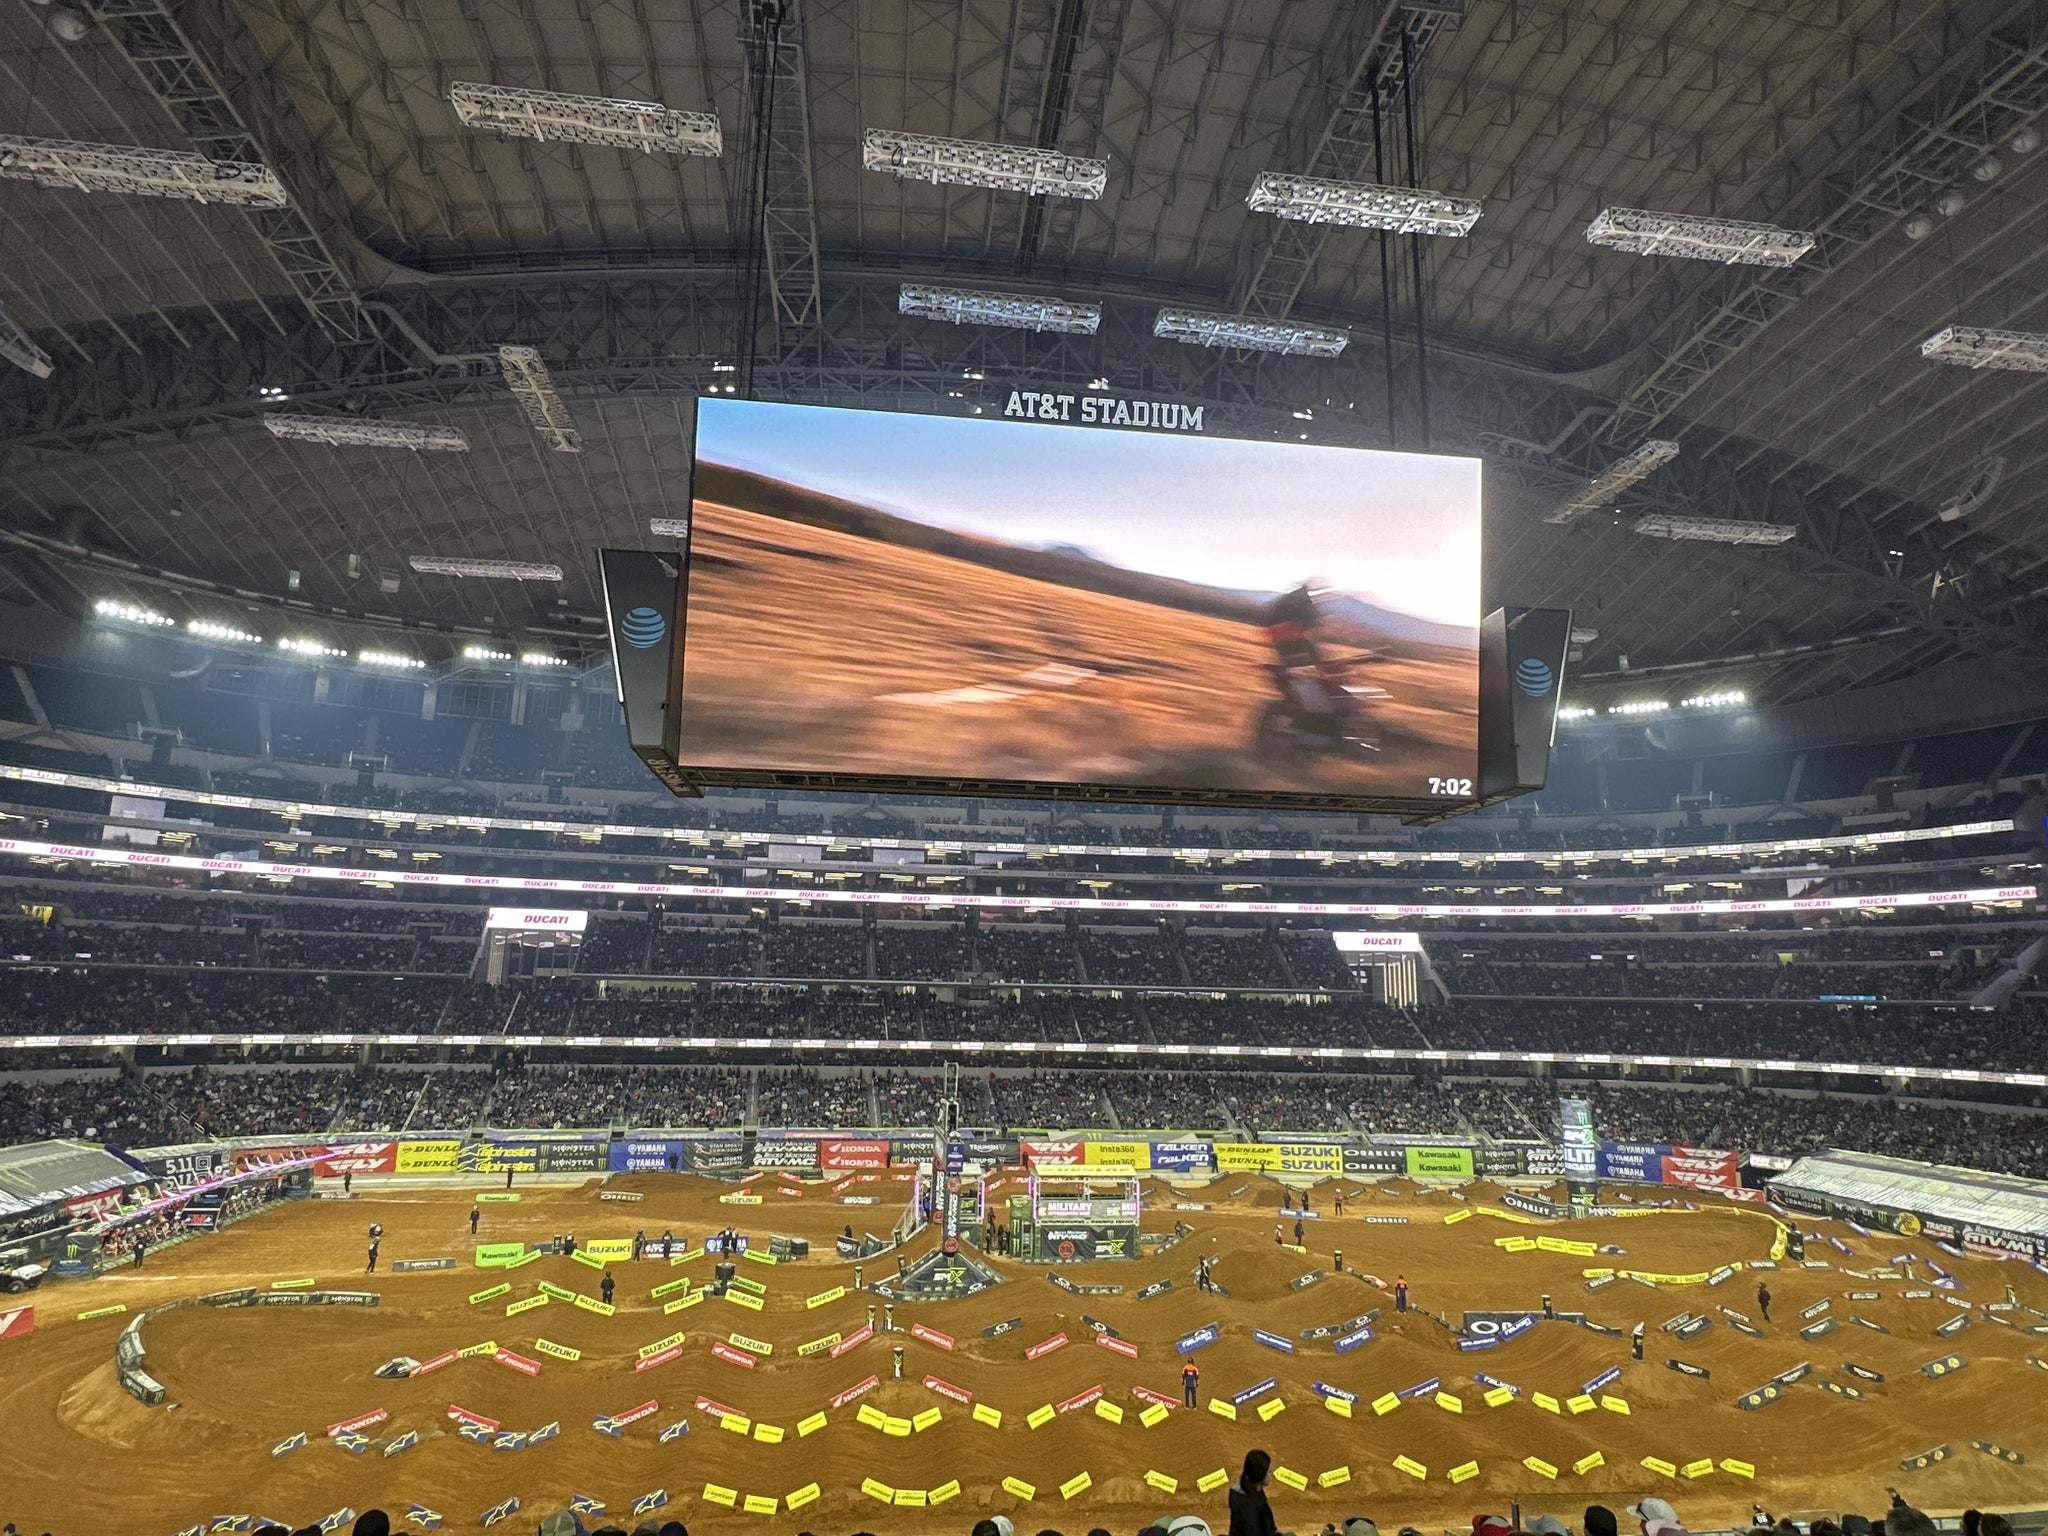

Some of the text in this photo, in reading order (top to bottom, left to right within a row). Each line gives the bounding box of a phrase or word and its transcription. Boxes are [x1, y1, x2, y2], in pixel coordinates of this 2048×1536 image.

[1004, 391, 1204, 431] AT&T STADIUM
[1428, 777, 1472, 796] 7:02
[50, 847, 95, 857] DUCATI
[128, 854, 171, 864] DUCATI
[202, 861, 242, 869] DUCATI
[272, 865, 311, 874] DUCATI
[339, 870, 377, 879] DUCATI
[403, 874, 439, 882] DUCATI
[464, 877, 499, 885] DUCATI
[524, 880, 557, 888] DUCATI
[638, 885, 669, 893] DUCATI
[1859, 897, 1898, 905] DUCATI
[1928, 893, 1968, 902] DUCATI
[1793, 900, 1831, 908] DUCATI
[523, 914, 569, 924] DUCATI
[1363, 937, 1402, 946] DUCATI
[413, 1145, 459, 1153] DUNLO
[636, 1144, 666, 1153] YAMAHA
[1100, 1145, 1135, 1153] Insta360
[1157, 1143, 1208, 1151] FALKEN
[1280, 1146, 1340, 1157] SUZUKI
[1626, 1146, 1655, 1155] YAMAHA
[1158, 1153, 1209, 1164] FALKEN
[1418, 1151, 1461, 1159] Kawasaki
[1614, 1154, 1644, 1163] YAMAHA
[166, 1157, 193, 1174] 5.11
[412, 1160, 459, 1168] DUNLO
[551, 1159, 594, 1167] MONSTER
[635, 1158, 665, 1167] YAMAHA
[1228, 1157, 1275, 1167] DUNLOP
[1281, 1159, 1341, 1171] SUZUKI
[1419, 1164, 1462, 1172] Kawasaki
[1615, 1168, 1645, 1177] YAMAHA
[1048, 1202, 1092, 1211] MILITARY
[1516, 1200, 1550, 1215] OAKLEY
[1589, 1207, 1616, 1216] MONS
[1975, 1225, 2000, 1237] ROCKY
[589, 1245, 630, 1254] SUZUKI
[481, 1250, 518, 1260] Kawasaki
[541, 1285, 573, 1300] Kawasaki
[655, 1281, 687, 1296] Kawasaki
[474, 1286, 506, 1302] Kawasaki
[729, 1291, 762, 1307] SUZUKI
[810, 1289, 842, 1304] SUZUKI
[510, 1296, 545, 1311] SUZUKI
[578, 1297, 612, 1313] SUZUKI
[666, 1294, 701, 1310] SUZUKI
[732, 1335, 770, 1352] SUZUKI
[841, 1329, 870, 1348] HONDA
[923, 1331, 952, 1347] HONDA
[538, 1341, 577, 1359] SUZUKI
[642, 1336, 681, 1357] SUZUKI
[801, 1336, 839, 1354] SUZUKI
[1037, 1336, 1066, 1354] HONDA
[1108, 1341, 1137, 1355] HONDA
[722, 1351, 754, 1366] HONDA
[505, 1357, 536, 1373] HONDA
[843, 1380, 878, 1402] HONDA
[935, 1385, 969, 1403] HONDA
[1069, 1391, 1103, 1410] HONDA
[342, 1414, 381, 1431] HONDA
